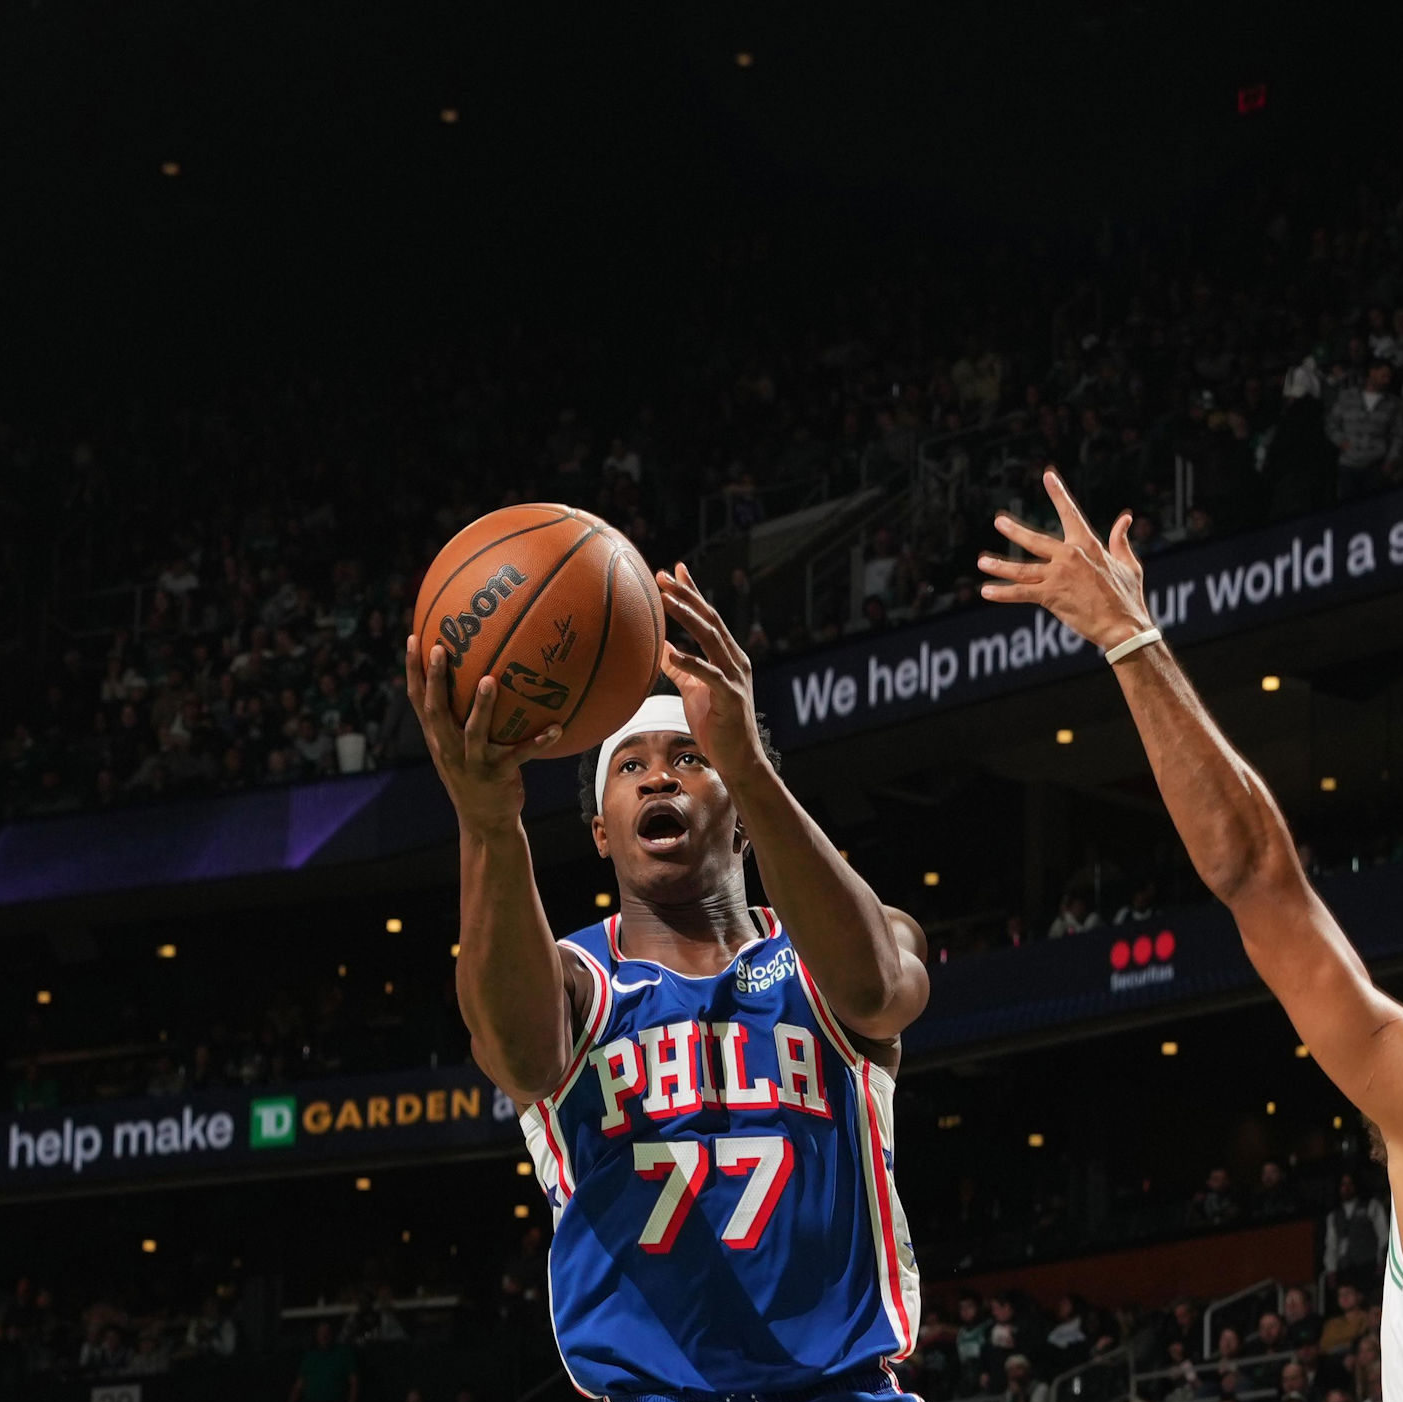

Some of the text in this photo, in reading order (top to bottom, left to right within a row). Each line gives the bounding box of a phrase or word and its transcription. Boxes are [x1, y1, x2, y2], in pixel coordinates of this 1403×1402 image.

[435, 563, 529, 680] lson
[793, 669, 858, 727] We
[866, 638, 961, 701] help
[967, 607, 1083, 682] make
[1205, 528, 1335, 616] world
[1345, 531, 1376, 578] a
[737, 946, 795, 979] Bloom
[737, 960, 795, 993] energy
[8, 1117, 101, 1174] help
[112, 1107, 233, 1161] make
[256, 1110, 292, 1140] TD
[301, 1088, 481, 1136] GARDEN
[590, 1019, 832, 1139] PHILA
[633, 1136, 795, 1254] 77
